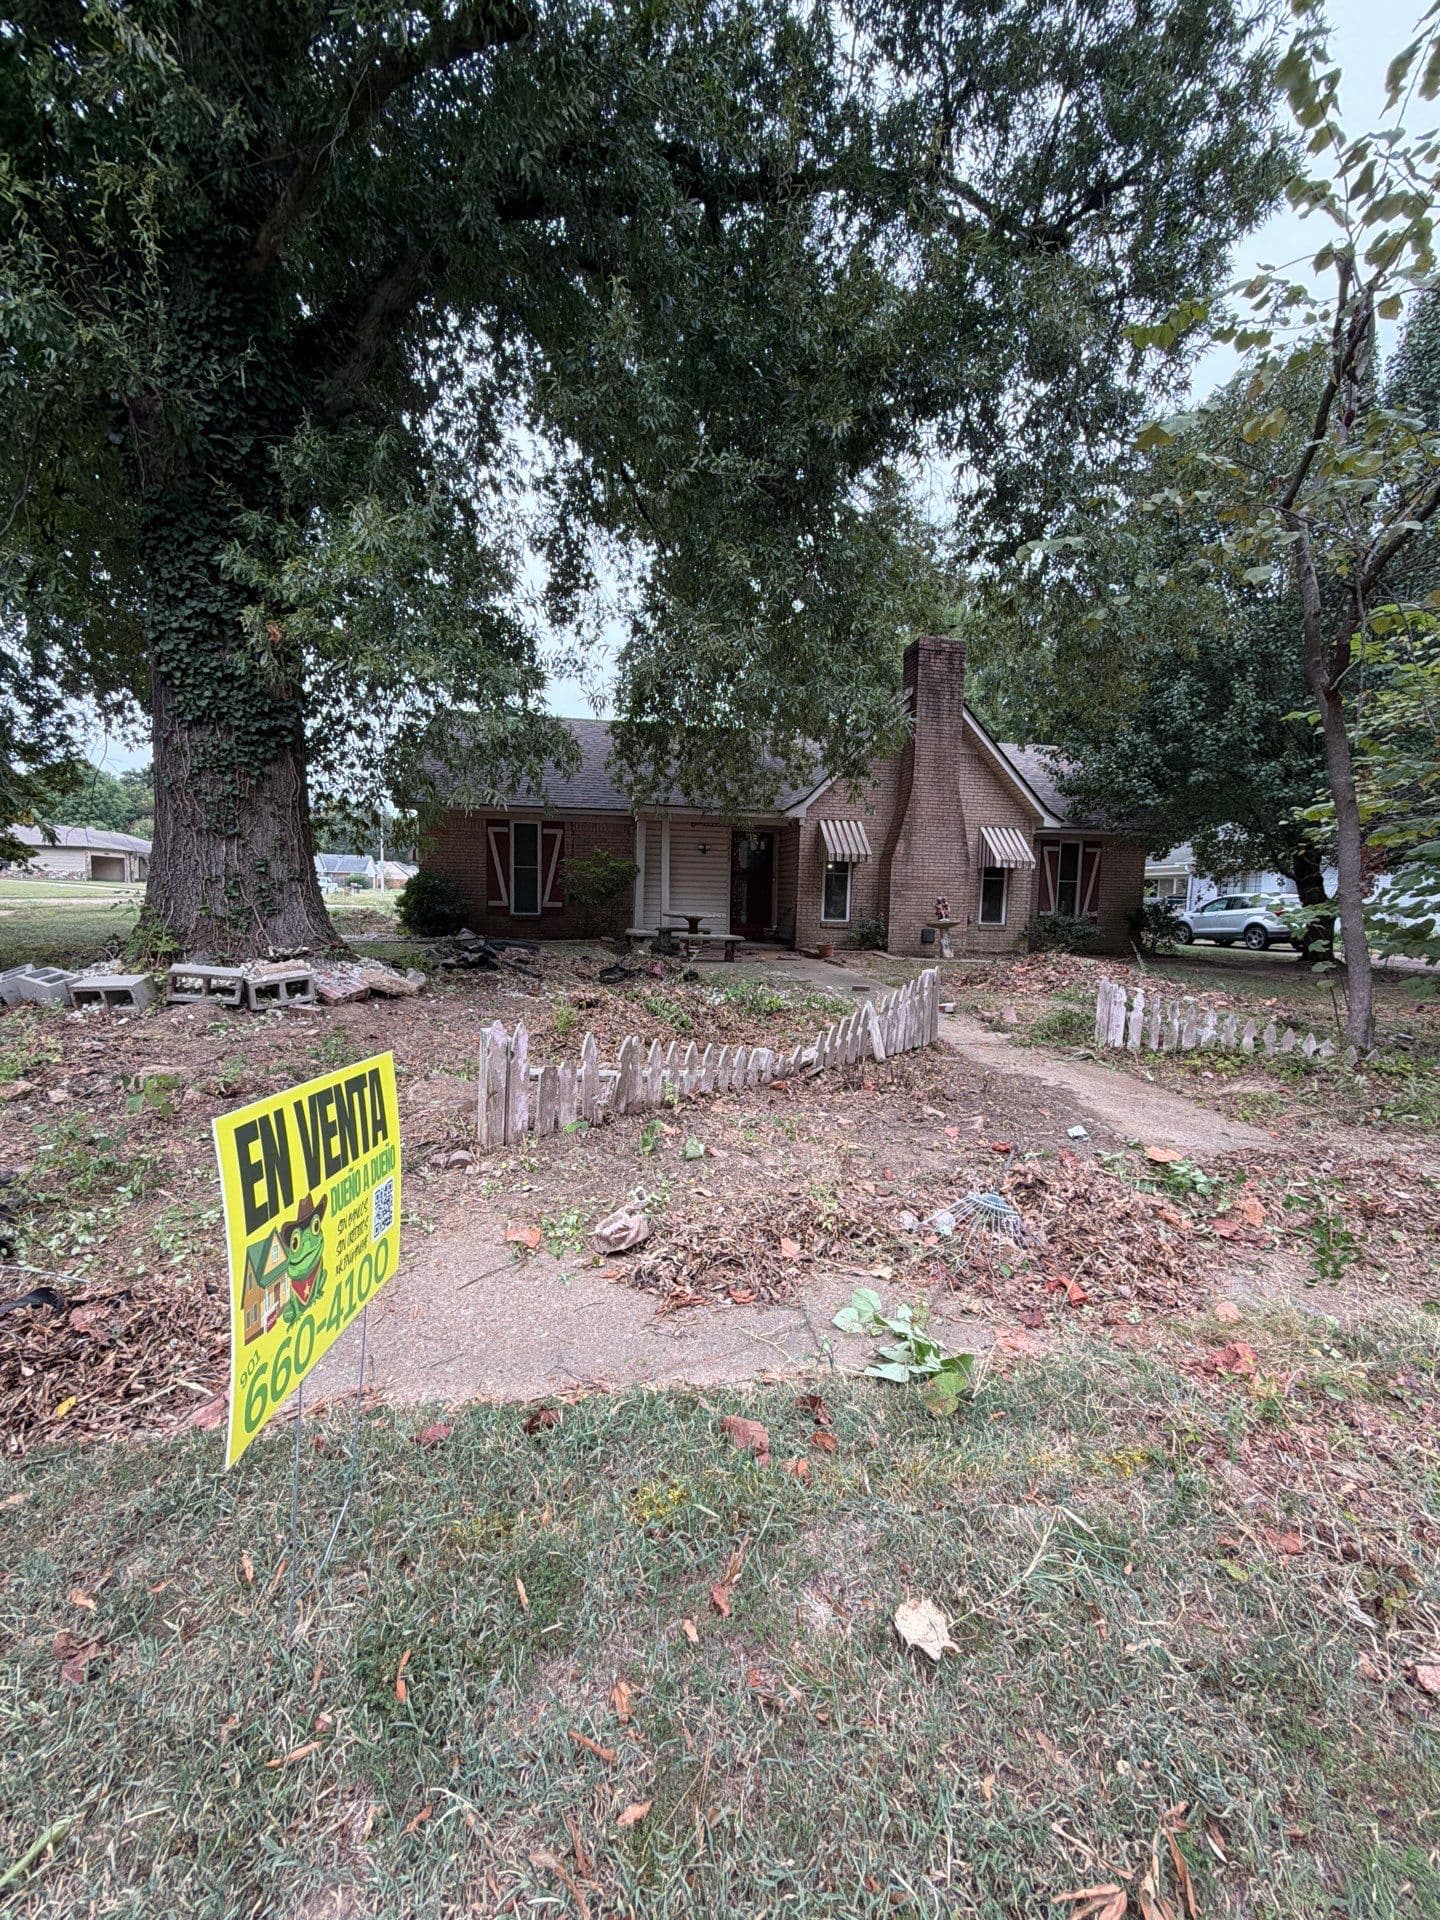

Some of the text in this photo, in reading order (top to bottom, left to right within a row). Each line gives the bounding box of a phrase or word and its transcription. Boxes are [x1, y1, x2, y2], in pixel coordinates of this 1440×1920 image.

[234, 1067, 388, 1236] EN VENTA
[330, 1167, 362, 1217] DUEÑO
[363, 1163, 370, 1192] A
[371, 1143, 396, 1186] DUEÑO
[239, 1349, 261, 1389] 901
[244, 1237, 389, 1434] 660-4100
